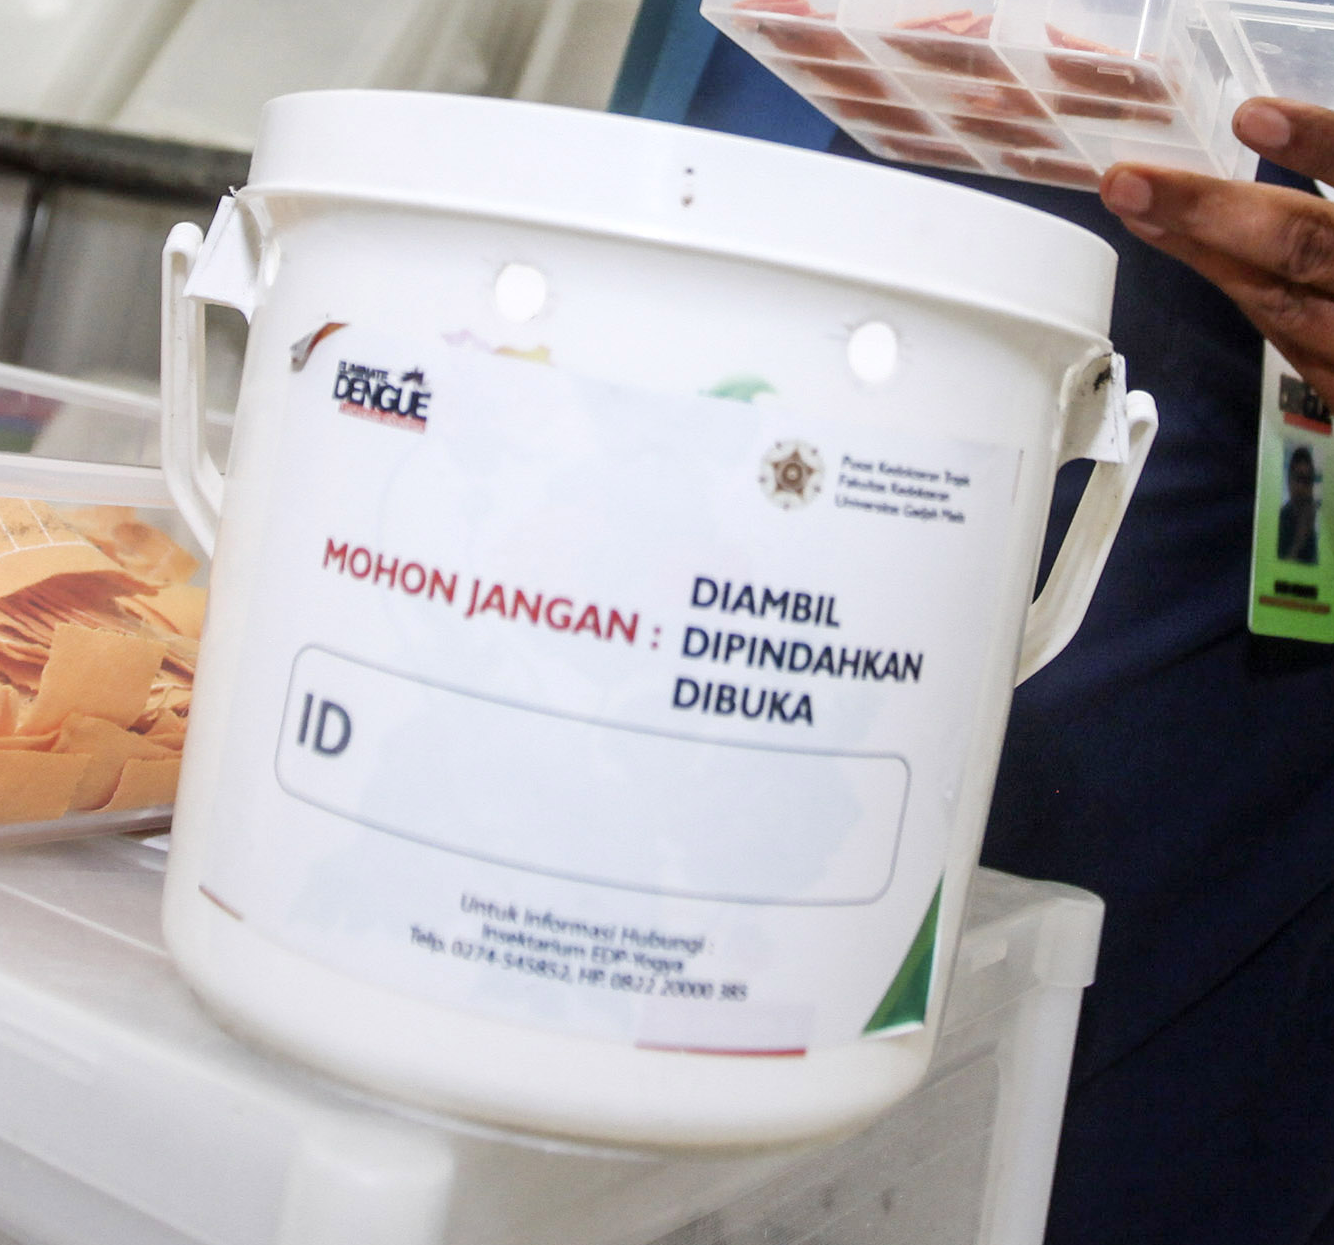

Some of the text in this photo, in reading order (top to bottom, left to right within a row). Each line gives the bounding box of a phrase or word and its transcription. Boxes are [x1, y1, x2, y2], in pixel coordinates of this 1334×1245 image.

[333, 373, 431, 423] DENGUE
[323, 538, 458, 604] MOHON
[465, 579, 640, 644] JANGAN
[690, 576, 840, 629] DIAMBIL
[681, 625, 924, 683] DIPINDAHKAN
[298, 693, 352, 757] ID
[672, 676, 814, 727] DIBUKA
[460, 892, 518, 923] Untuk
[523, 907, 616, 942] Informasi
[622, 925, 705, 957] Hubungi
[482, 921, 586, 956] Insektarium
